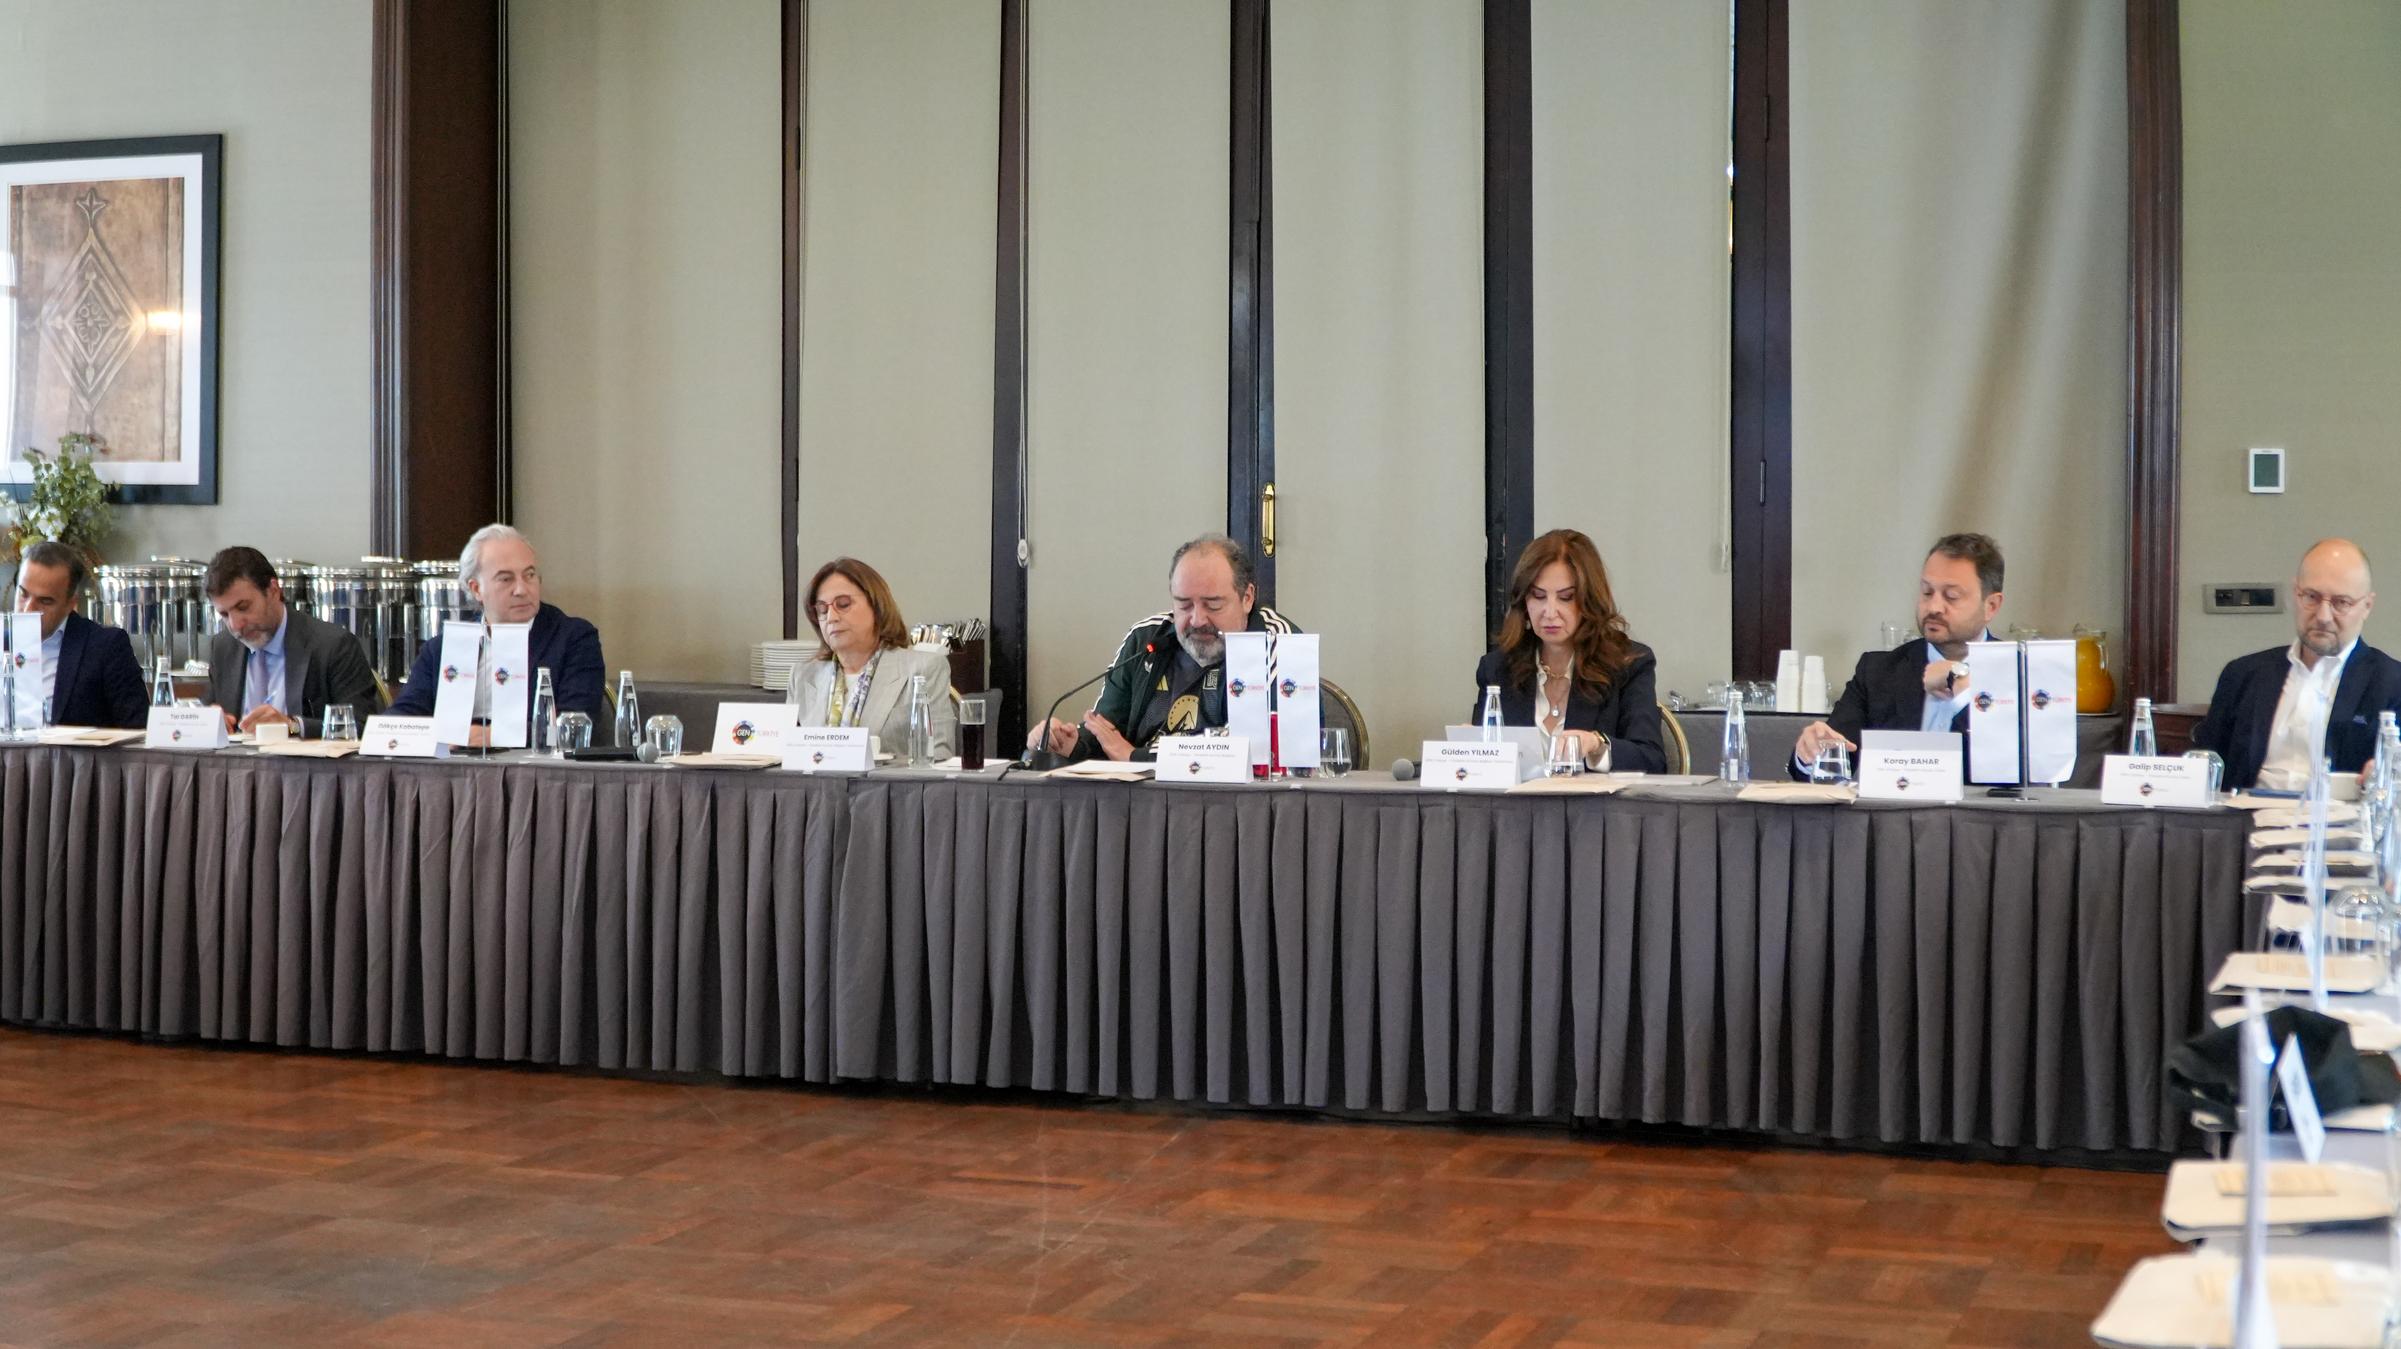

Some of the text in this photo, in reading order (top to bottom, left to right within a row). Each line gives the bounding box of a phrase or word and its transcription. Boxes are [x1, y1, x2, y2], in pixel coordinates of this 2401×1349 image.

[737, 729, 752, 737] GEN
[803, 733, 825, 741] Emine
[1178, 743, 1205, 751] Nevzat
[1441, 748, 1500, 757] Gülden YILMAZ
[1883, 757, 1909, 766] Koray
[2128, 762, 2152, 772] Galip
